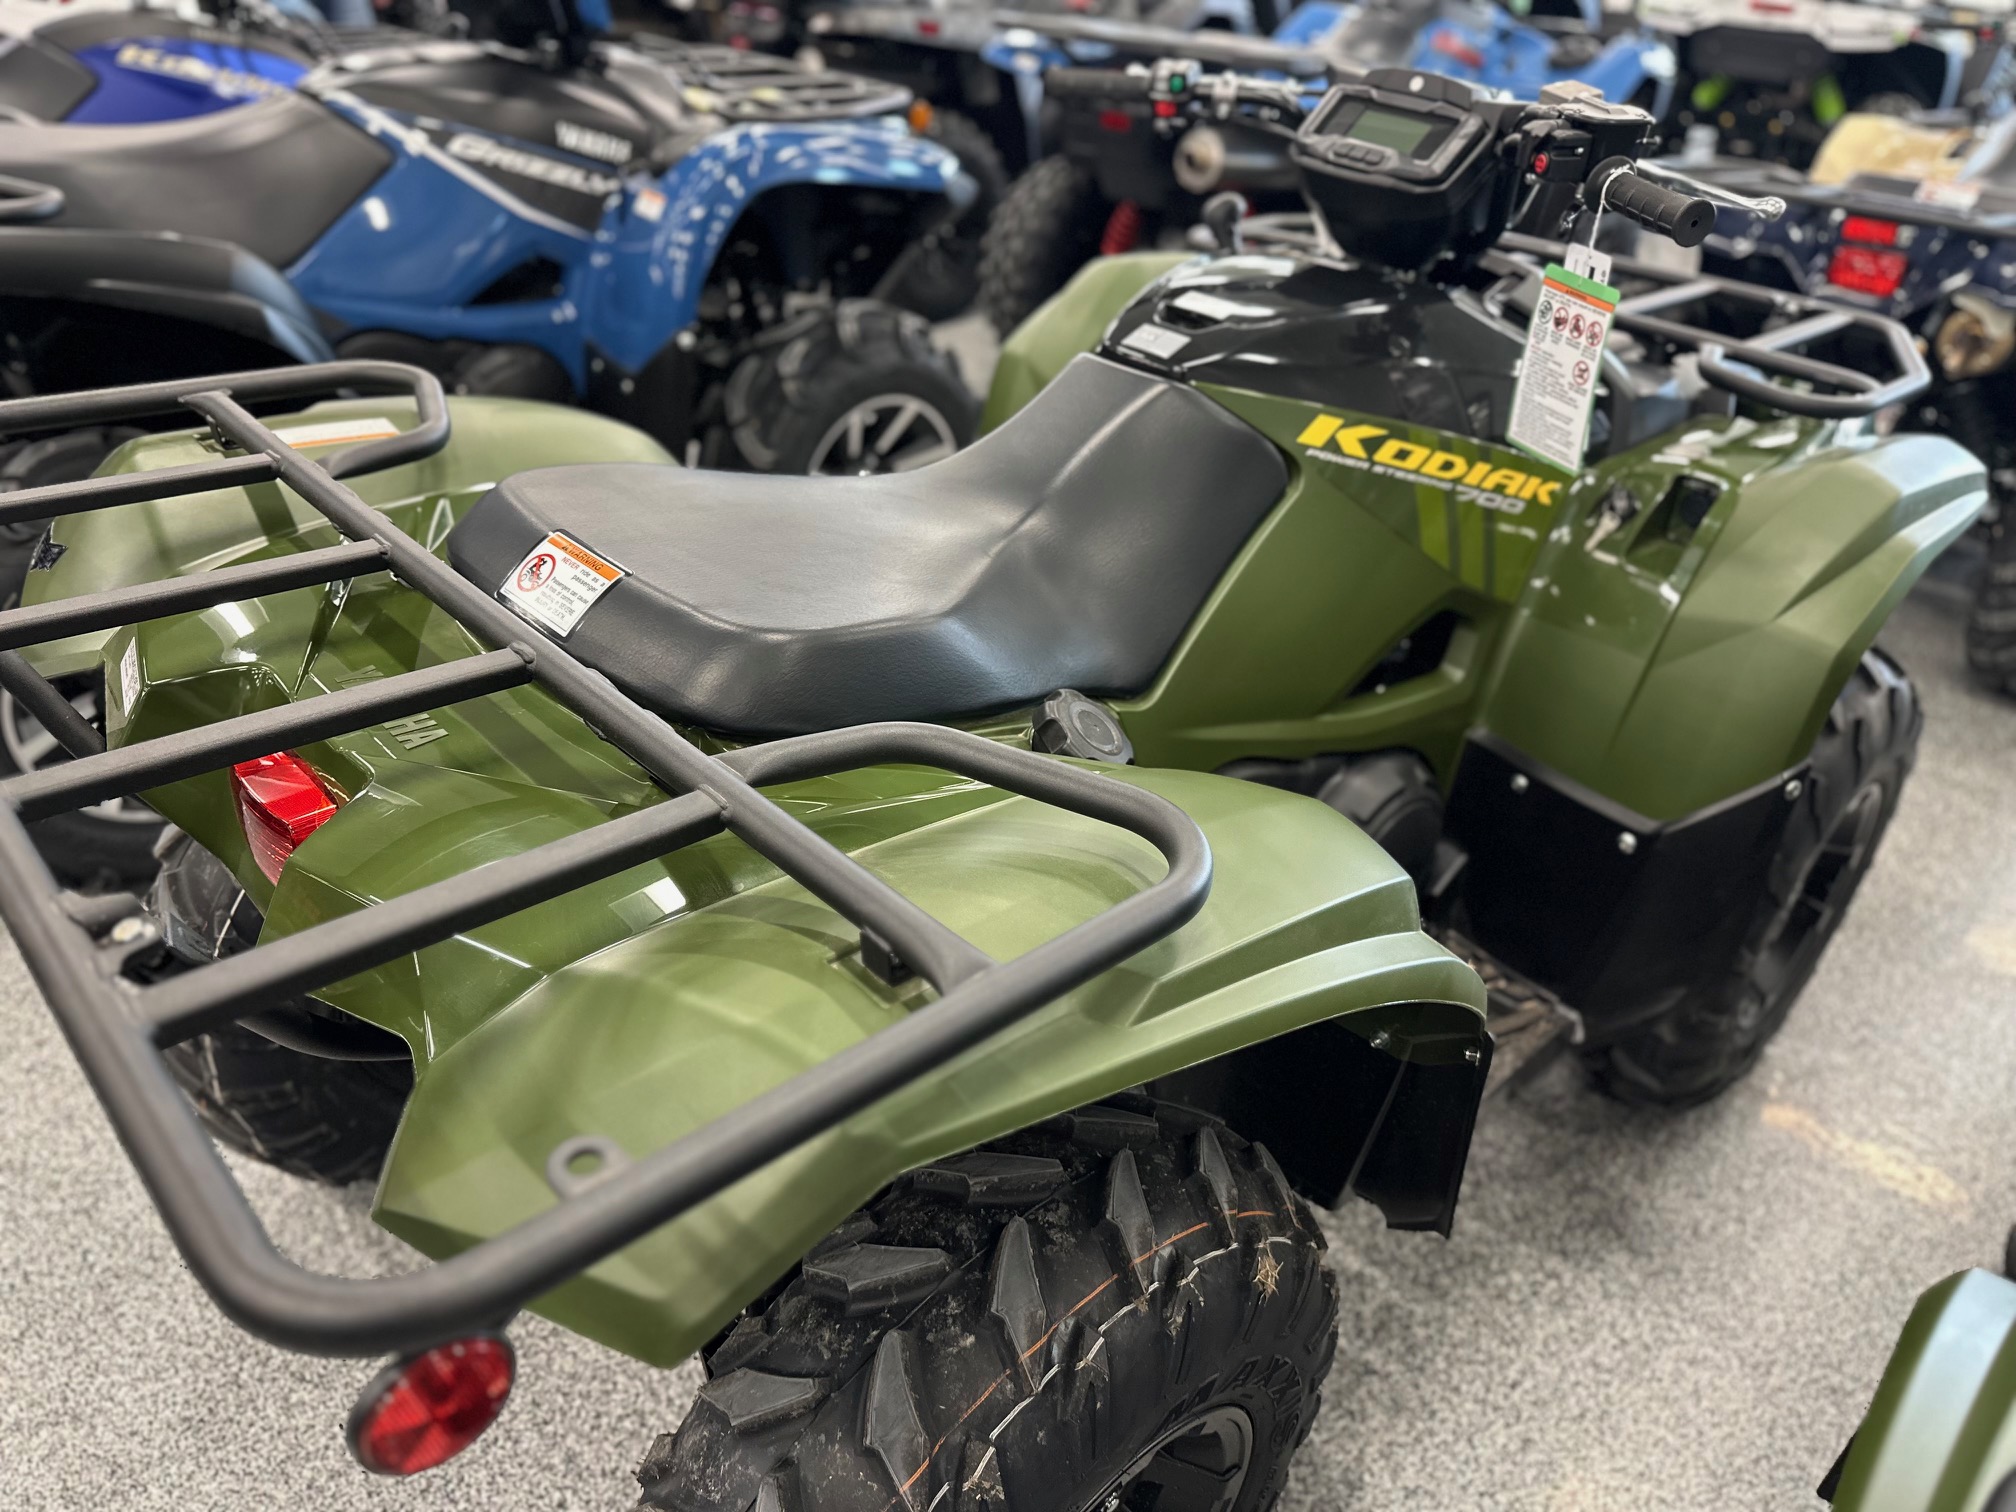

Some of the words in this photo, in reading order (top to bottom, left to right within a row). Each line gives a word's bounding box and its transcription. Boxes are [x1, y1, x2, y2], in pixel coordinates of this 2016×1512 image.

[1296, 413, 1562, 505] KODIAK
[1305, 448, 1371, 471] POWER
[1371, 464, 1455, 491] STEERING
[1454, 484, 1528, 515] 700
[561, 556, 580, 570] NEVER
[580, 569, 591, 578] ride
[569, 546, 604, 571] WARNING
[551, 576, 571, 593] Passengers
[577, 595, 589, 605] cause
[334, 664, 449, 750] YHA
